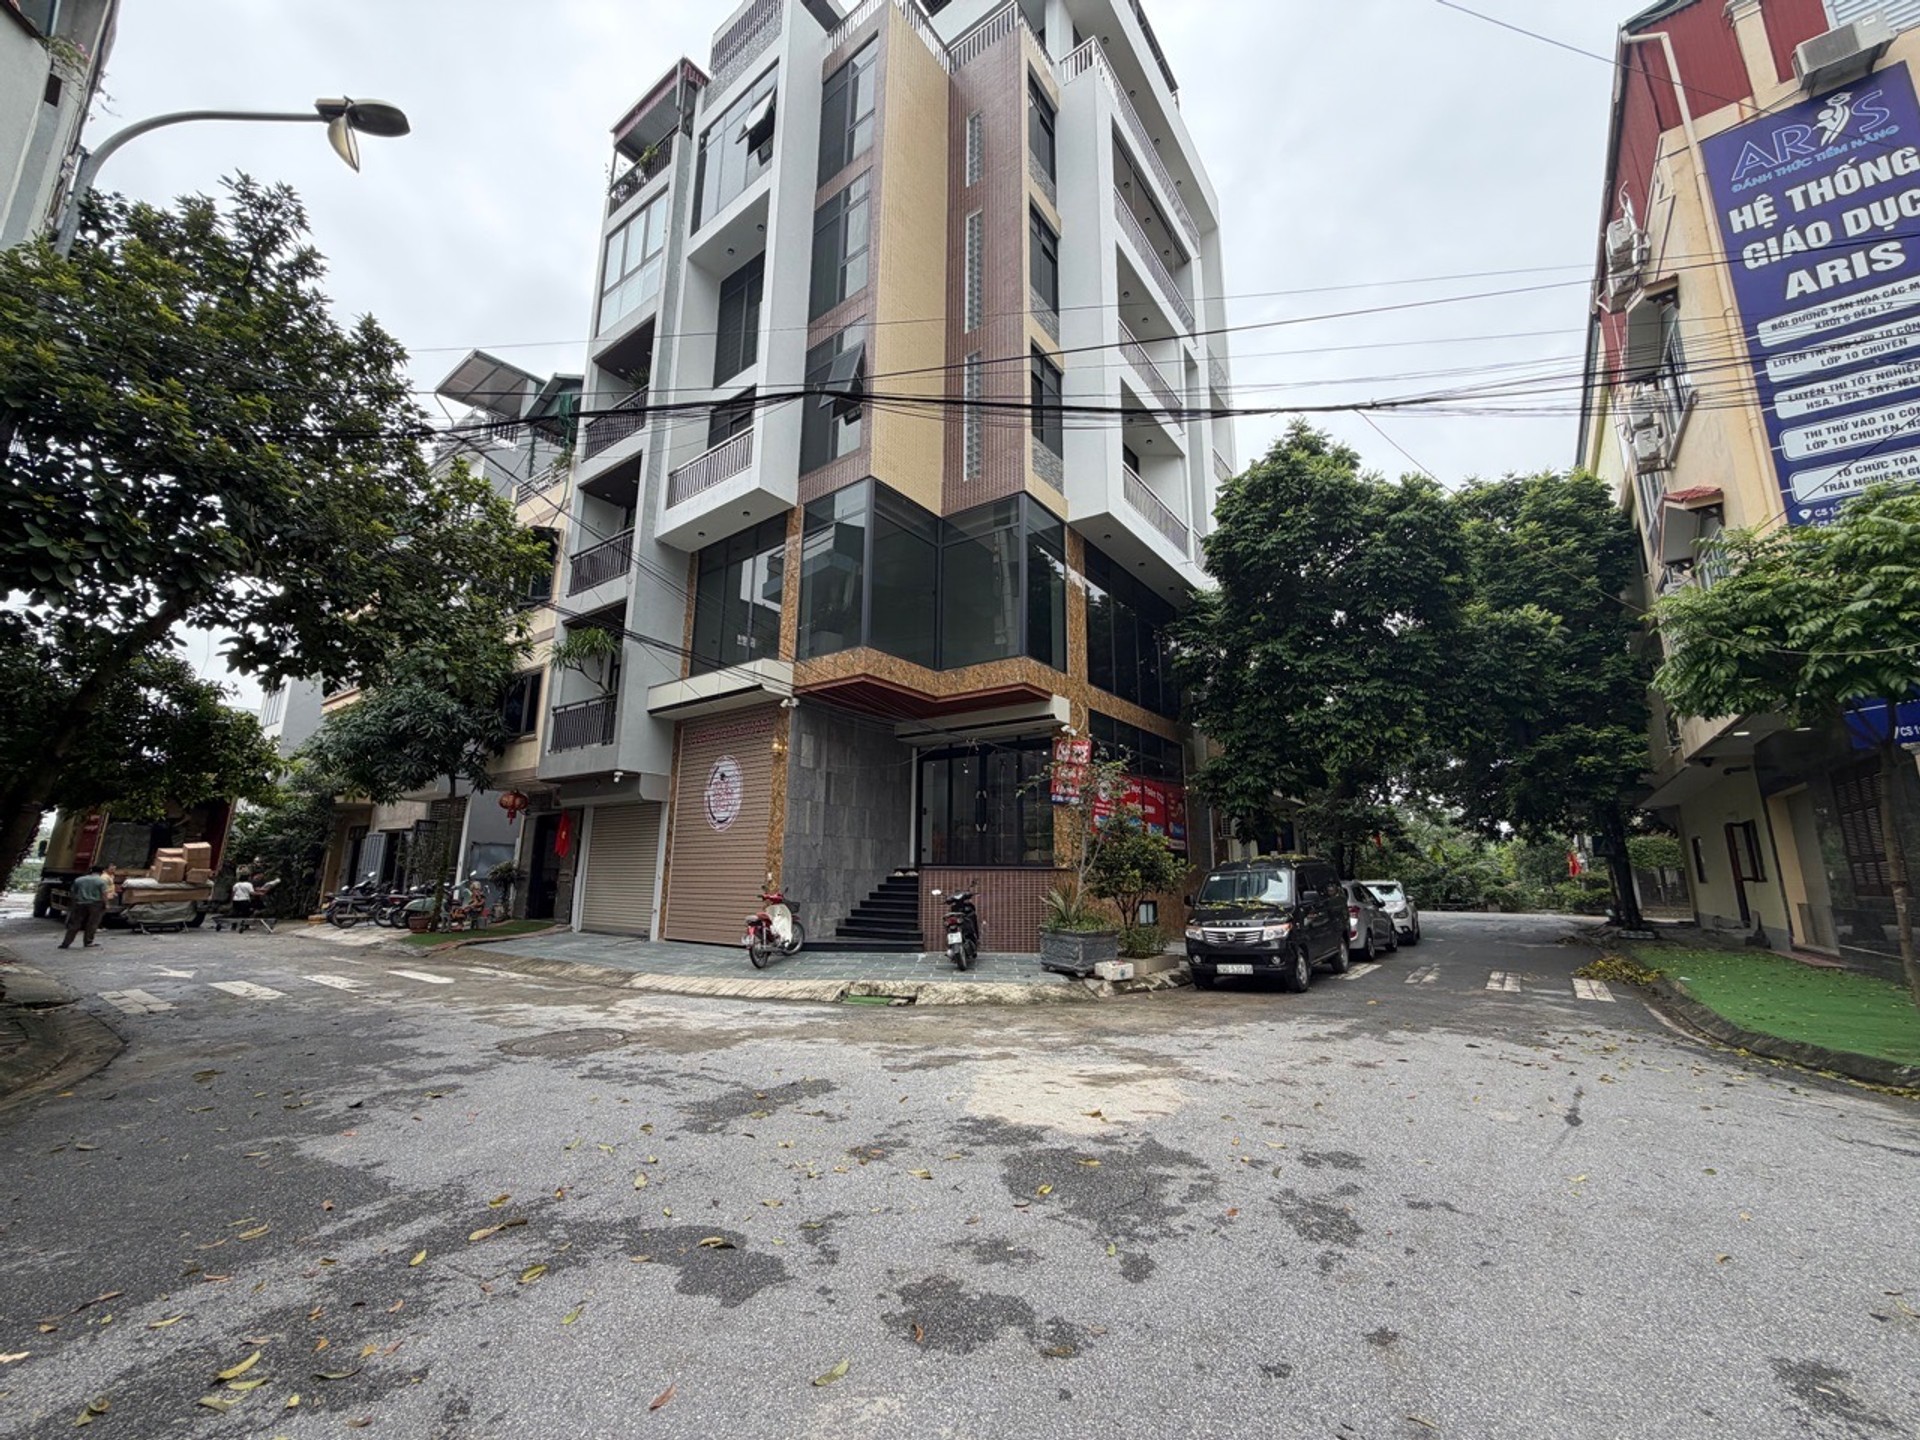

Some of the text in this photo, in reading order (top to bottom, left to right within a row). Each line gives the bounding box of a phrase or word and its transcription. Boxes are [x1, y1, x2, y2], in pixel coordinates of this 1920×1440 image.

[1731, 172, 1773, 192] ĐÁNH
[1774, 157, 1813, 177] THỨC
[1850, 124, 1901, 149] NĂNG
[1728, 146, 1920, 234] HỆ THỐNG
[1742, 188, 1920, 270] GIÁO DỤC
[1785, 241, 1907, 300] ARIS
[1882, 284, 1907, 299] CÁC
[1880, 302, 1893, 311] 12
[1877, 328, 1893, 338] 10
[1820, 337, 1908, 368] LỚP 10 CHUYÊN
[1829, 381, 1848, 393] THI
[1804, 430, 1823, 440] THI
[1825, 419, 1850, 435] THỬ
[1852, 416, 1876, 429] VÀO
[1881, 412, 1895, 422] 10
[1806, 439, 1828, 451] LỚP
[1832, 436, 1847, 445] 10
[1856, 460, 1889, 474] CHỨC
[1824, 478, 1850, 492] TRẢI
